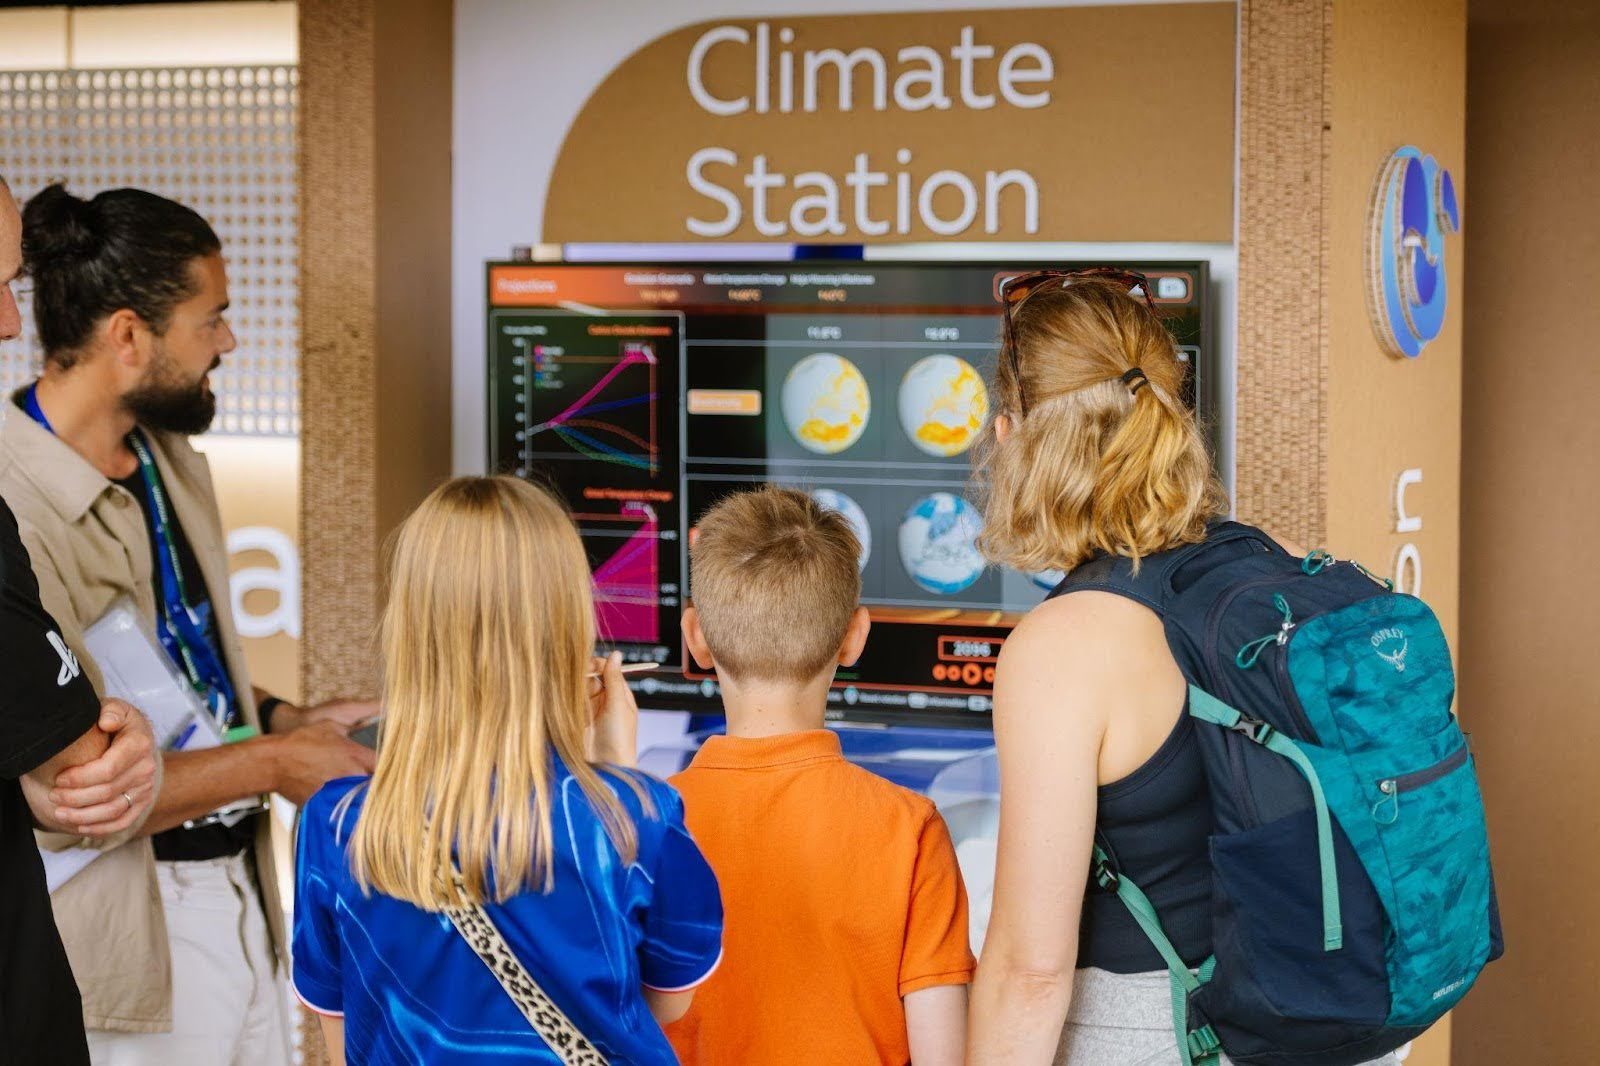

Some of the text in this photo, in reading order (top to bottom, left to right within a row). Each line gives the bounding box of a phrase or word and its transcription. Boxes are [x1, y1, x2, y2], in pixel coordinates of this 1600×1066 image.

[686, 21, 1055, 117] Climate
[685, 146, 1040, 237] Station
[1370, 628, 1404, 647] OSPREY
